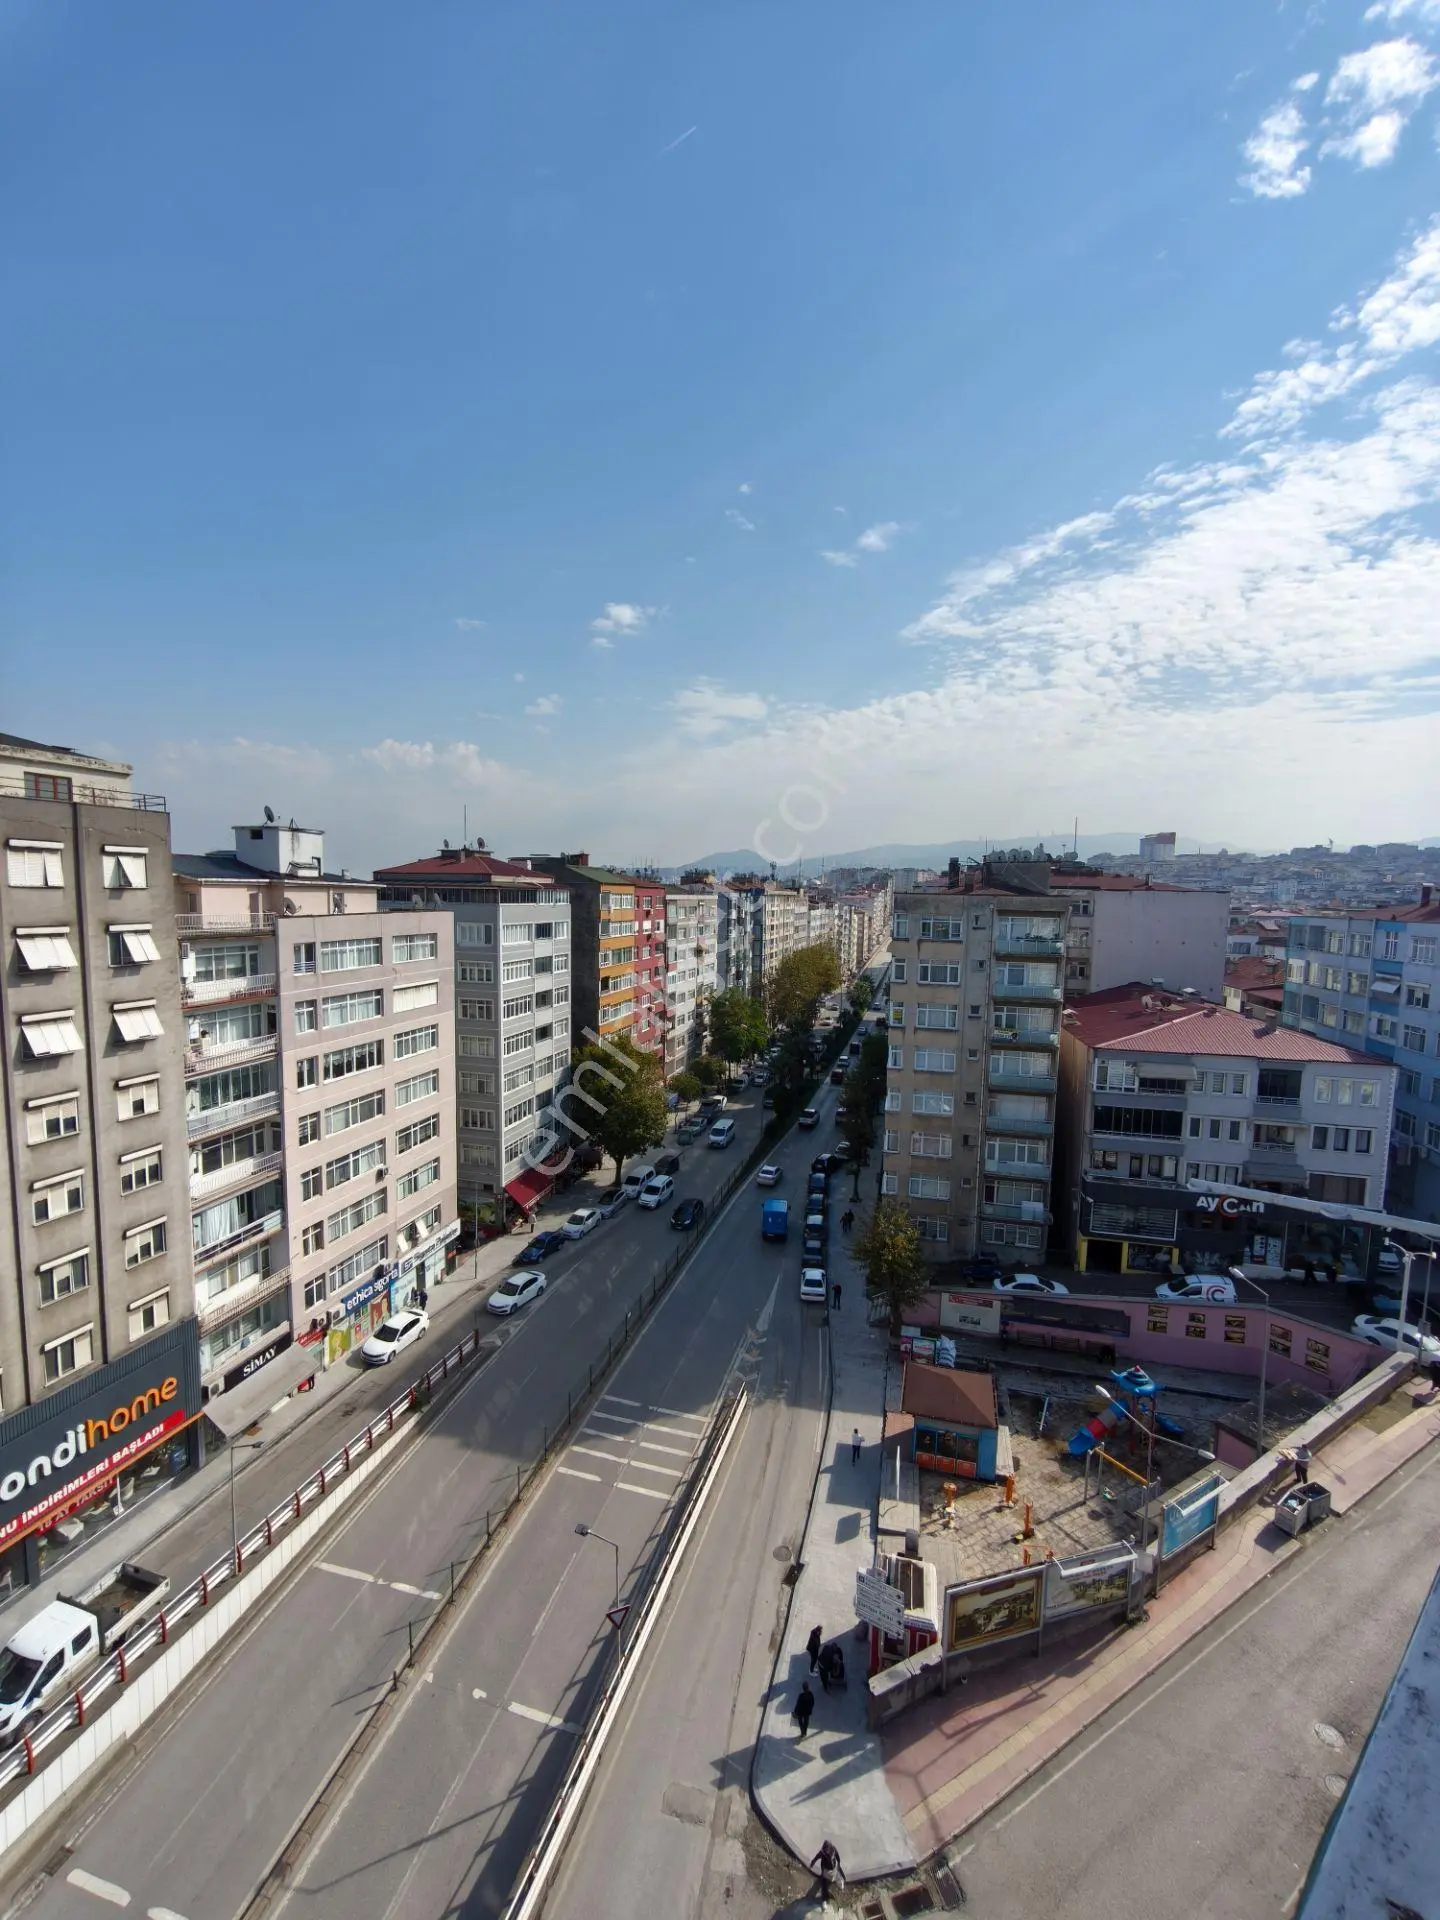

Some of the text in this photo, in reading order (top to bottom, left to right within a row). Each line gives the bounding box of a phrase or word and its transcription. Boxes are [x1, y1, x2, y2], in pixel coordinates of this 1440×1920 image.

[346, 1286, 373, 1310] ethica
[243, 1345, 277, 1377] SİMAY
[22, 1457, 110, 1525] İNDİRİMLERİ
[112, 1423, 164, 1465] BAŞLADI
